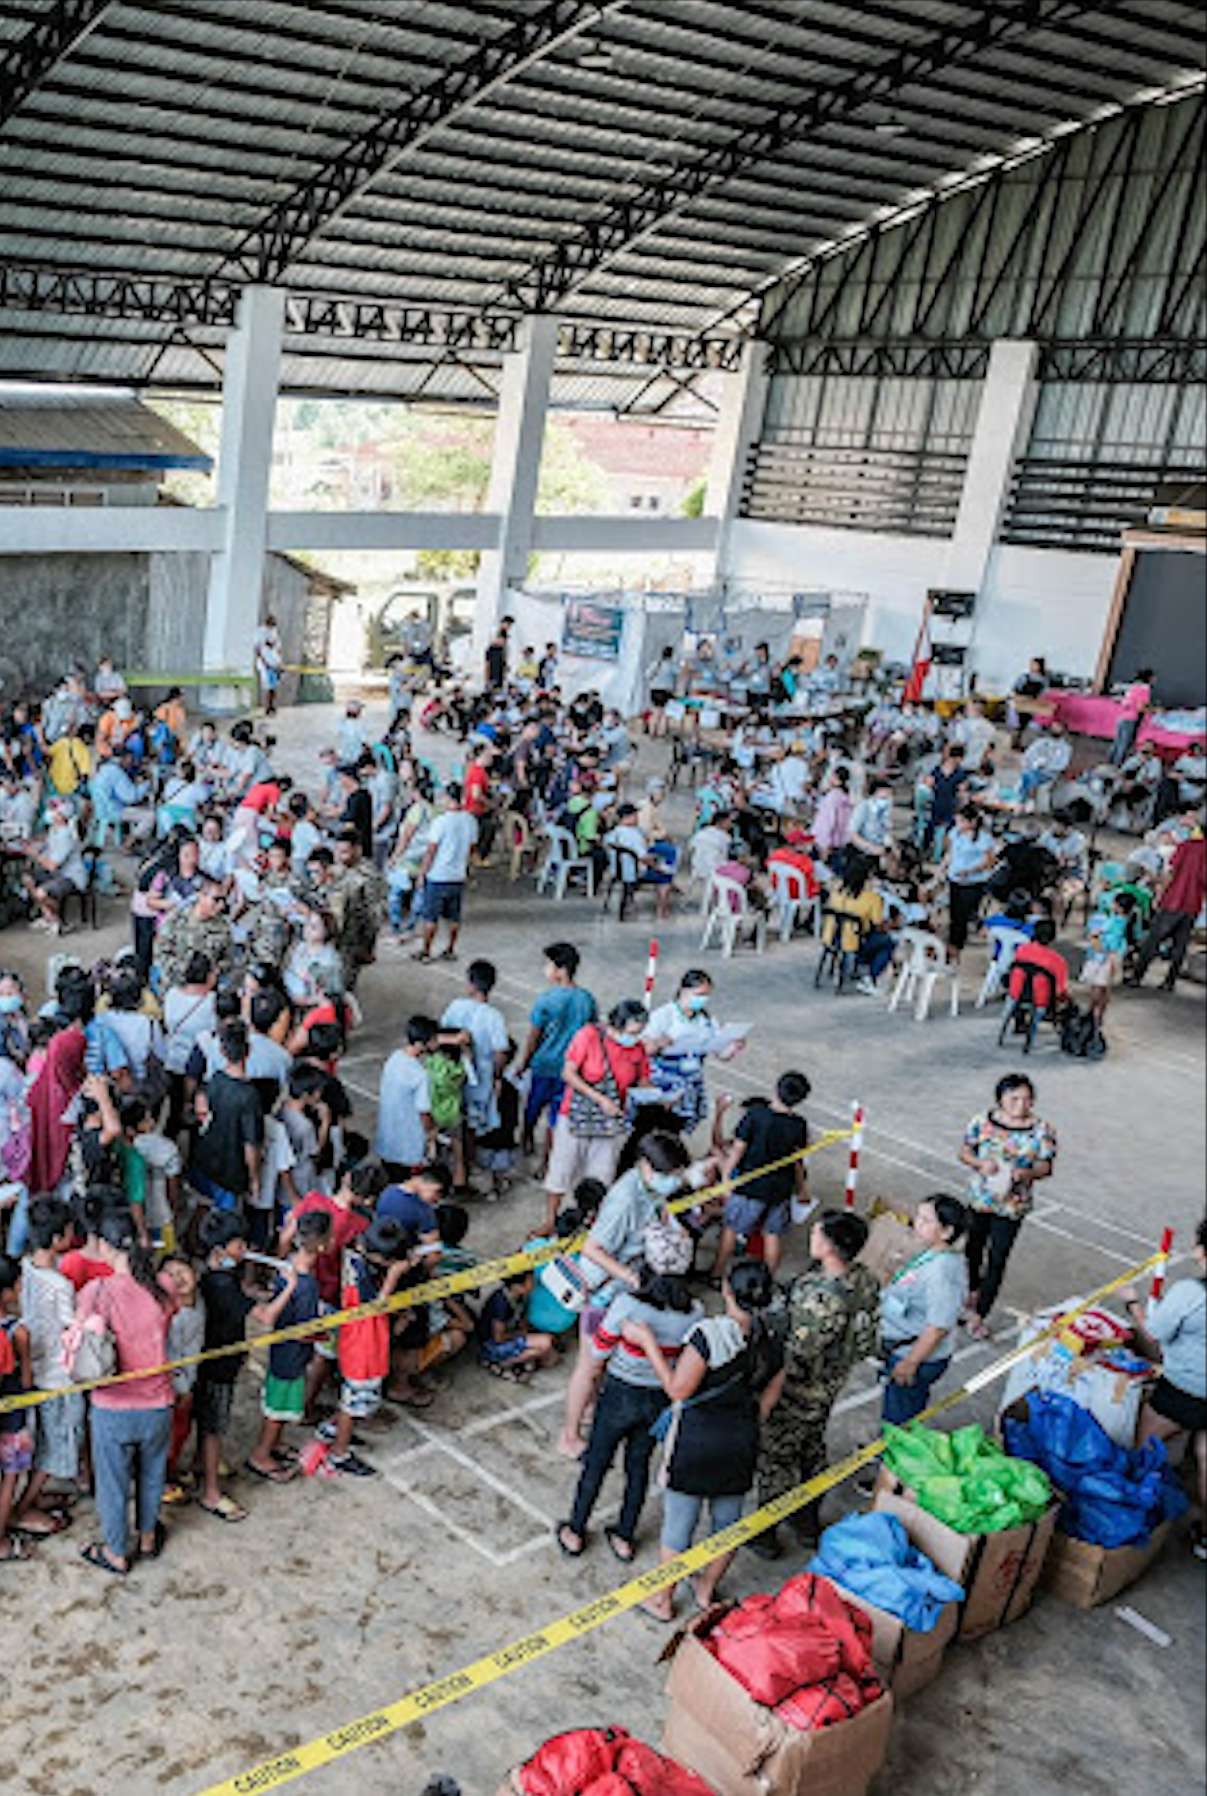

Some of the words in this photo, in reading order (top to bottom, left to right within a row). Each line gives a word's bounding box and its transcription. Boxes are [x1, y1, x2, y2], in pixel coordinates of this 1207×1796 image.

[234, 1756, 301, 1793] CAUTION
[326, 1713, 390, 1750] CAUTION
[413, 1672, 474, 1708] CAUTION
[492, 1635, 550, 1670] CAUTION
[568, 1596, 621, 1630] CAUTION
[637, 1560, 689, 1591] CAUTION
